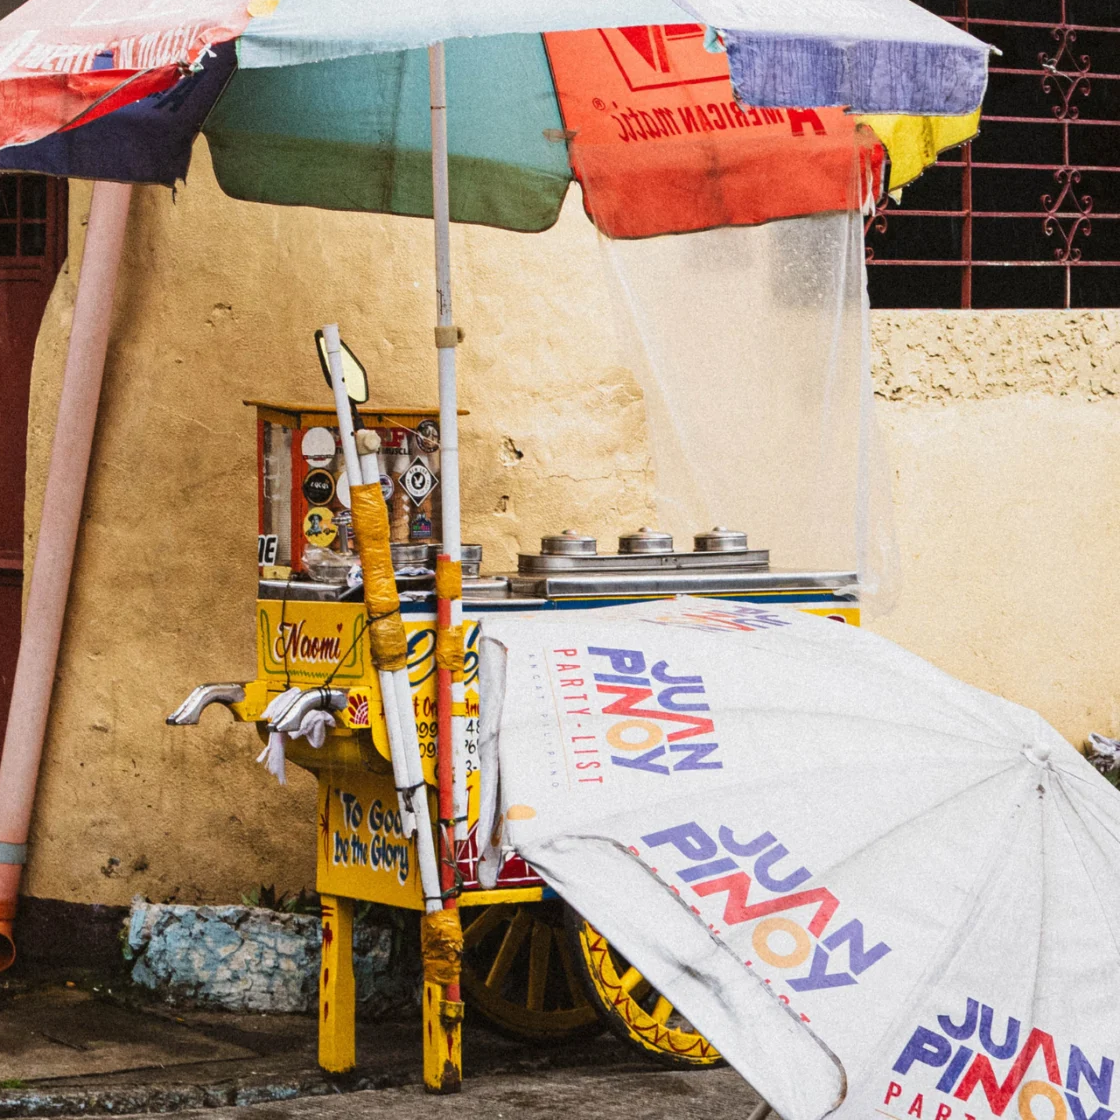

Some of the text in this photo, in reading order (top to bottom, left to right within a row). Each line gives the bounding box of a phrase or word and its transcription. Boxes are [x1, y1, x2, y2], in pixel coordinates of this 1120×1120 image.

[274, 620, 342, 663] Naomi
[587, 646, 671, 776] PINOY
[650, 659, 724, 772] JUAN
[332, 830, 349, 868] be
[350, 832, 368, 867] the
[718, 824, 893, 977] JUAN
[640, 821, 859, 993] PINOY
[883, 1080, 976, 1120] PAR
[936, 996, 1115, 1106] JUAN
